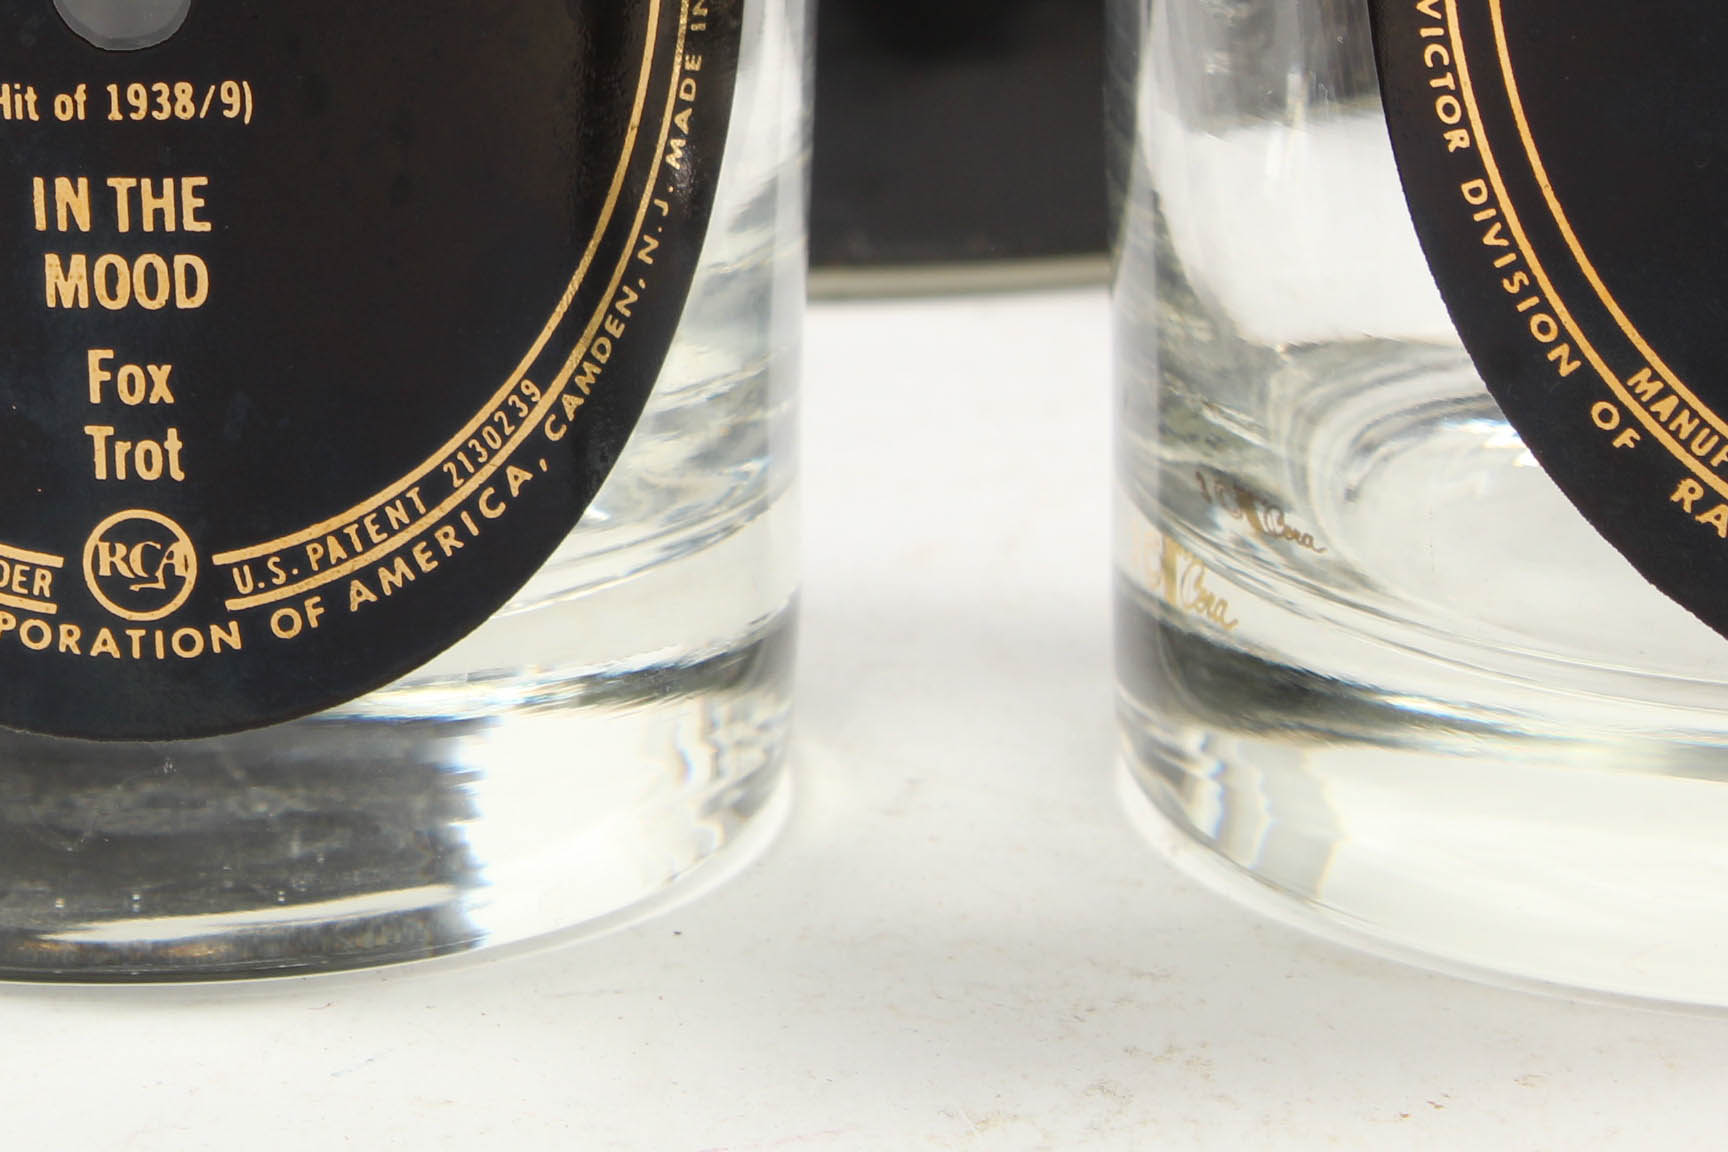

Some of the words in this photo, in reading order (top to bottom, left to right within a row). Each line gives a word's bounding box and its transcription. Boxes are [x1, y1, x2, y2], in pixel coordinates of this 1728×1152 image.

[54, 83, 87, 122] of
[106, 80, 254, 126] 1938/9)
[32, 176, 92, 233] IN
[106, 176, 213, 233] THE
[43, 253, 210, 311] MOOD
[1460, 178, 1582, 378] DIVISION
[1590, 400, 1642, 450] OF
[270, 596, 325, 640] OF
[349, 457, 549, 613] AMERICA,
[665, 54, 703, 170] MADE
[86, 348, 176, 406] Fox
[83, 424, 186, 482] Trot
[232, 556, 300, 595] U.S.
[306, 486, 428, 572] PATENT
[442, 378, 541, 489] 2130239
[96, 540, 189, 592] RCA
